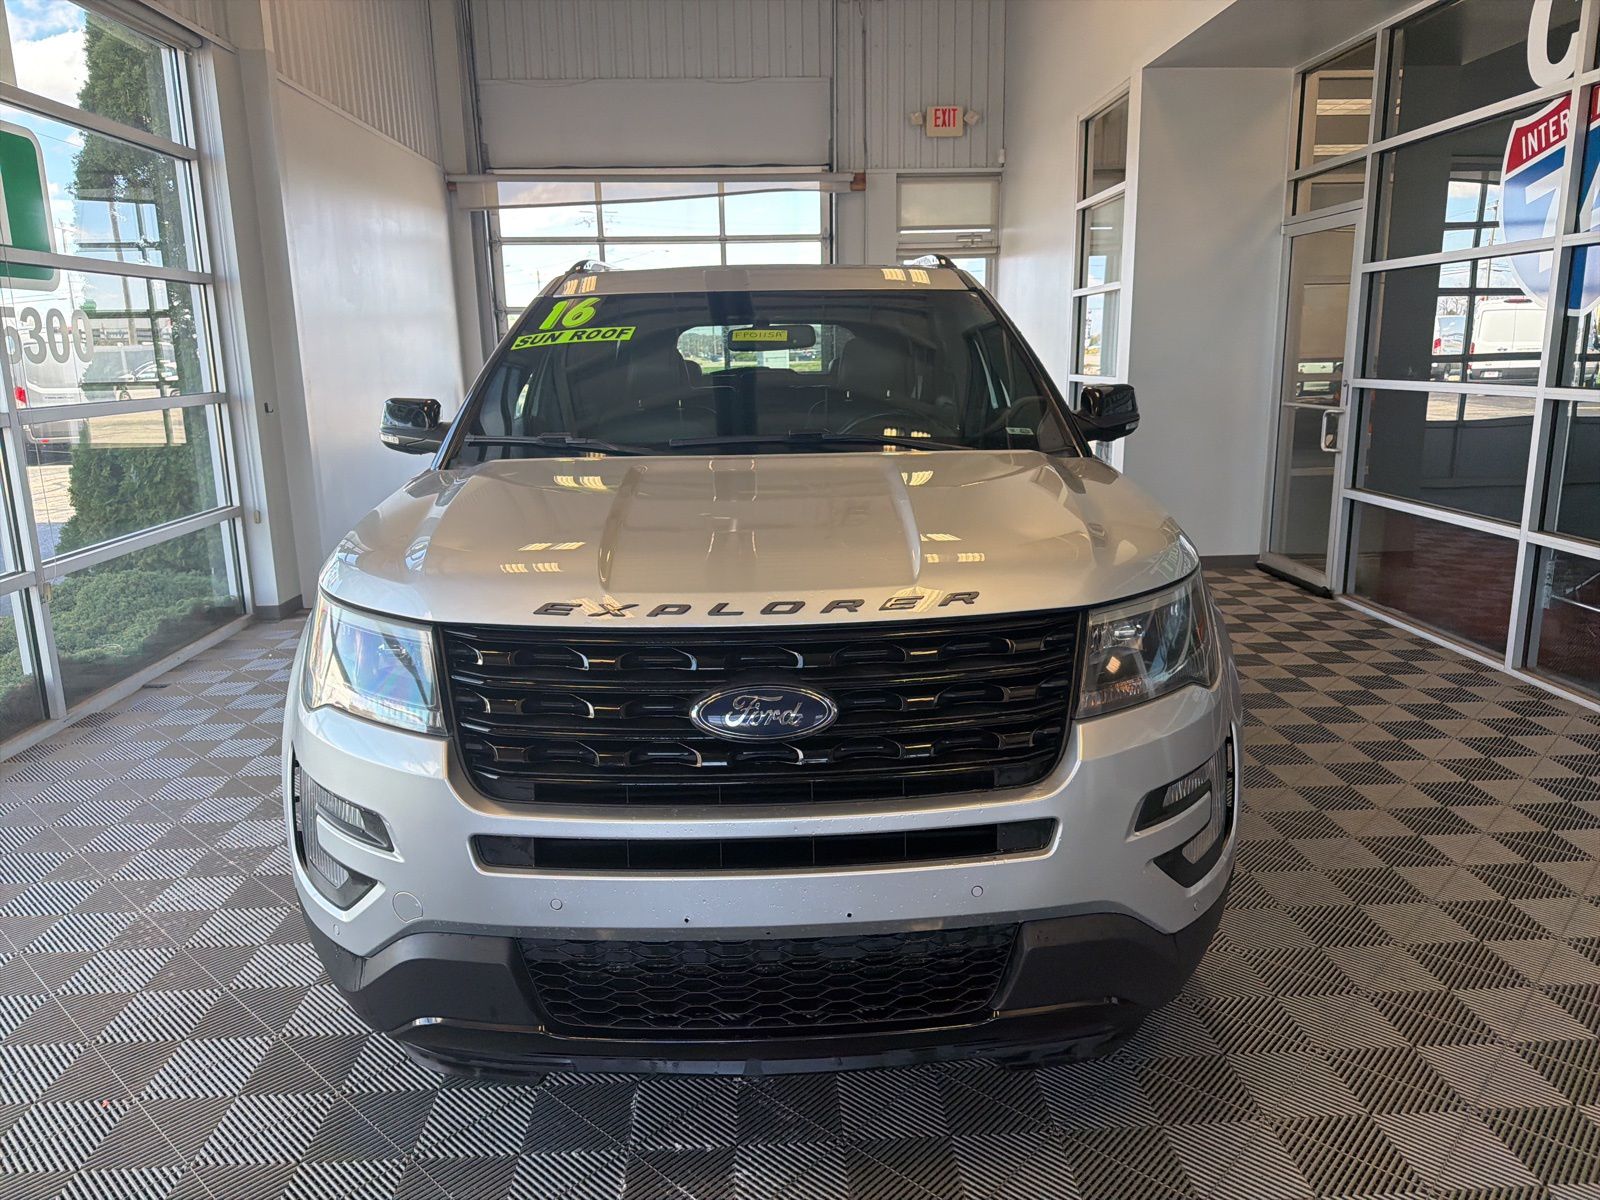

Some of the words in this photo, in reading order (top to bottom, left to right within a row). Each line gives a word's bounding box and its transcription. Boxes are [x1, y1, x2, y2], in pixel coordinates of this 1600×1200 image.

[933, 108, 958, 128] EXIT
[538, 296, 601, 331] 16
[514, 331, 566, 348] SUN
[568, 328, 633, 341] ROOF
[532, 590, 981, 617] EXPLORER
[724, 694, 804, 728] Ford
